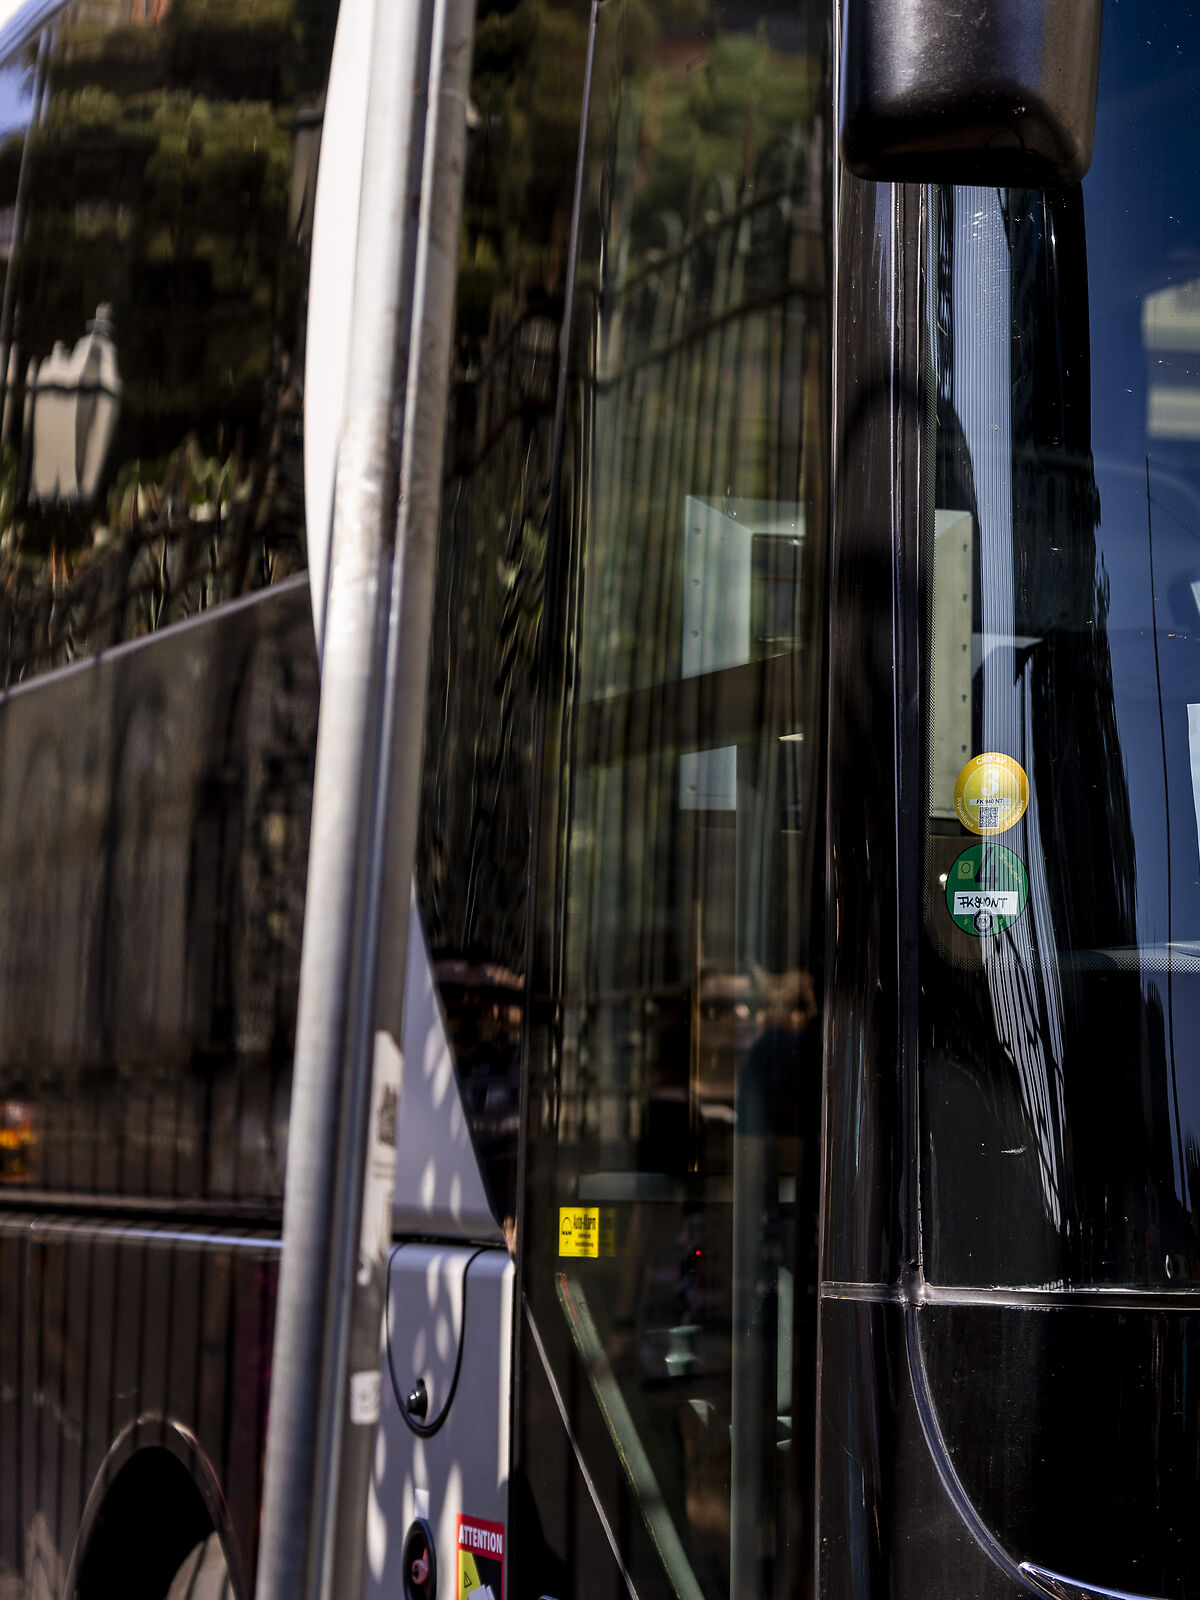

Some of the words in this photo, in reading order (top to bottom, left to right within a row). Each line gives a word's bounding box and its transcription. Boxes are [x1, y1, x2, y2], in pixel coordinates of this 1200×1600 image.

[981, 768, 1001, 797] 3
[974, 846, 999, 890] 4
[458, 1524, 503, 1555] ATTENTION
